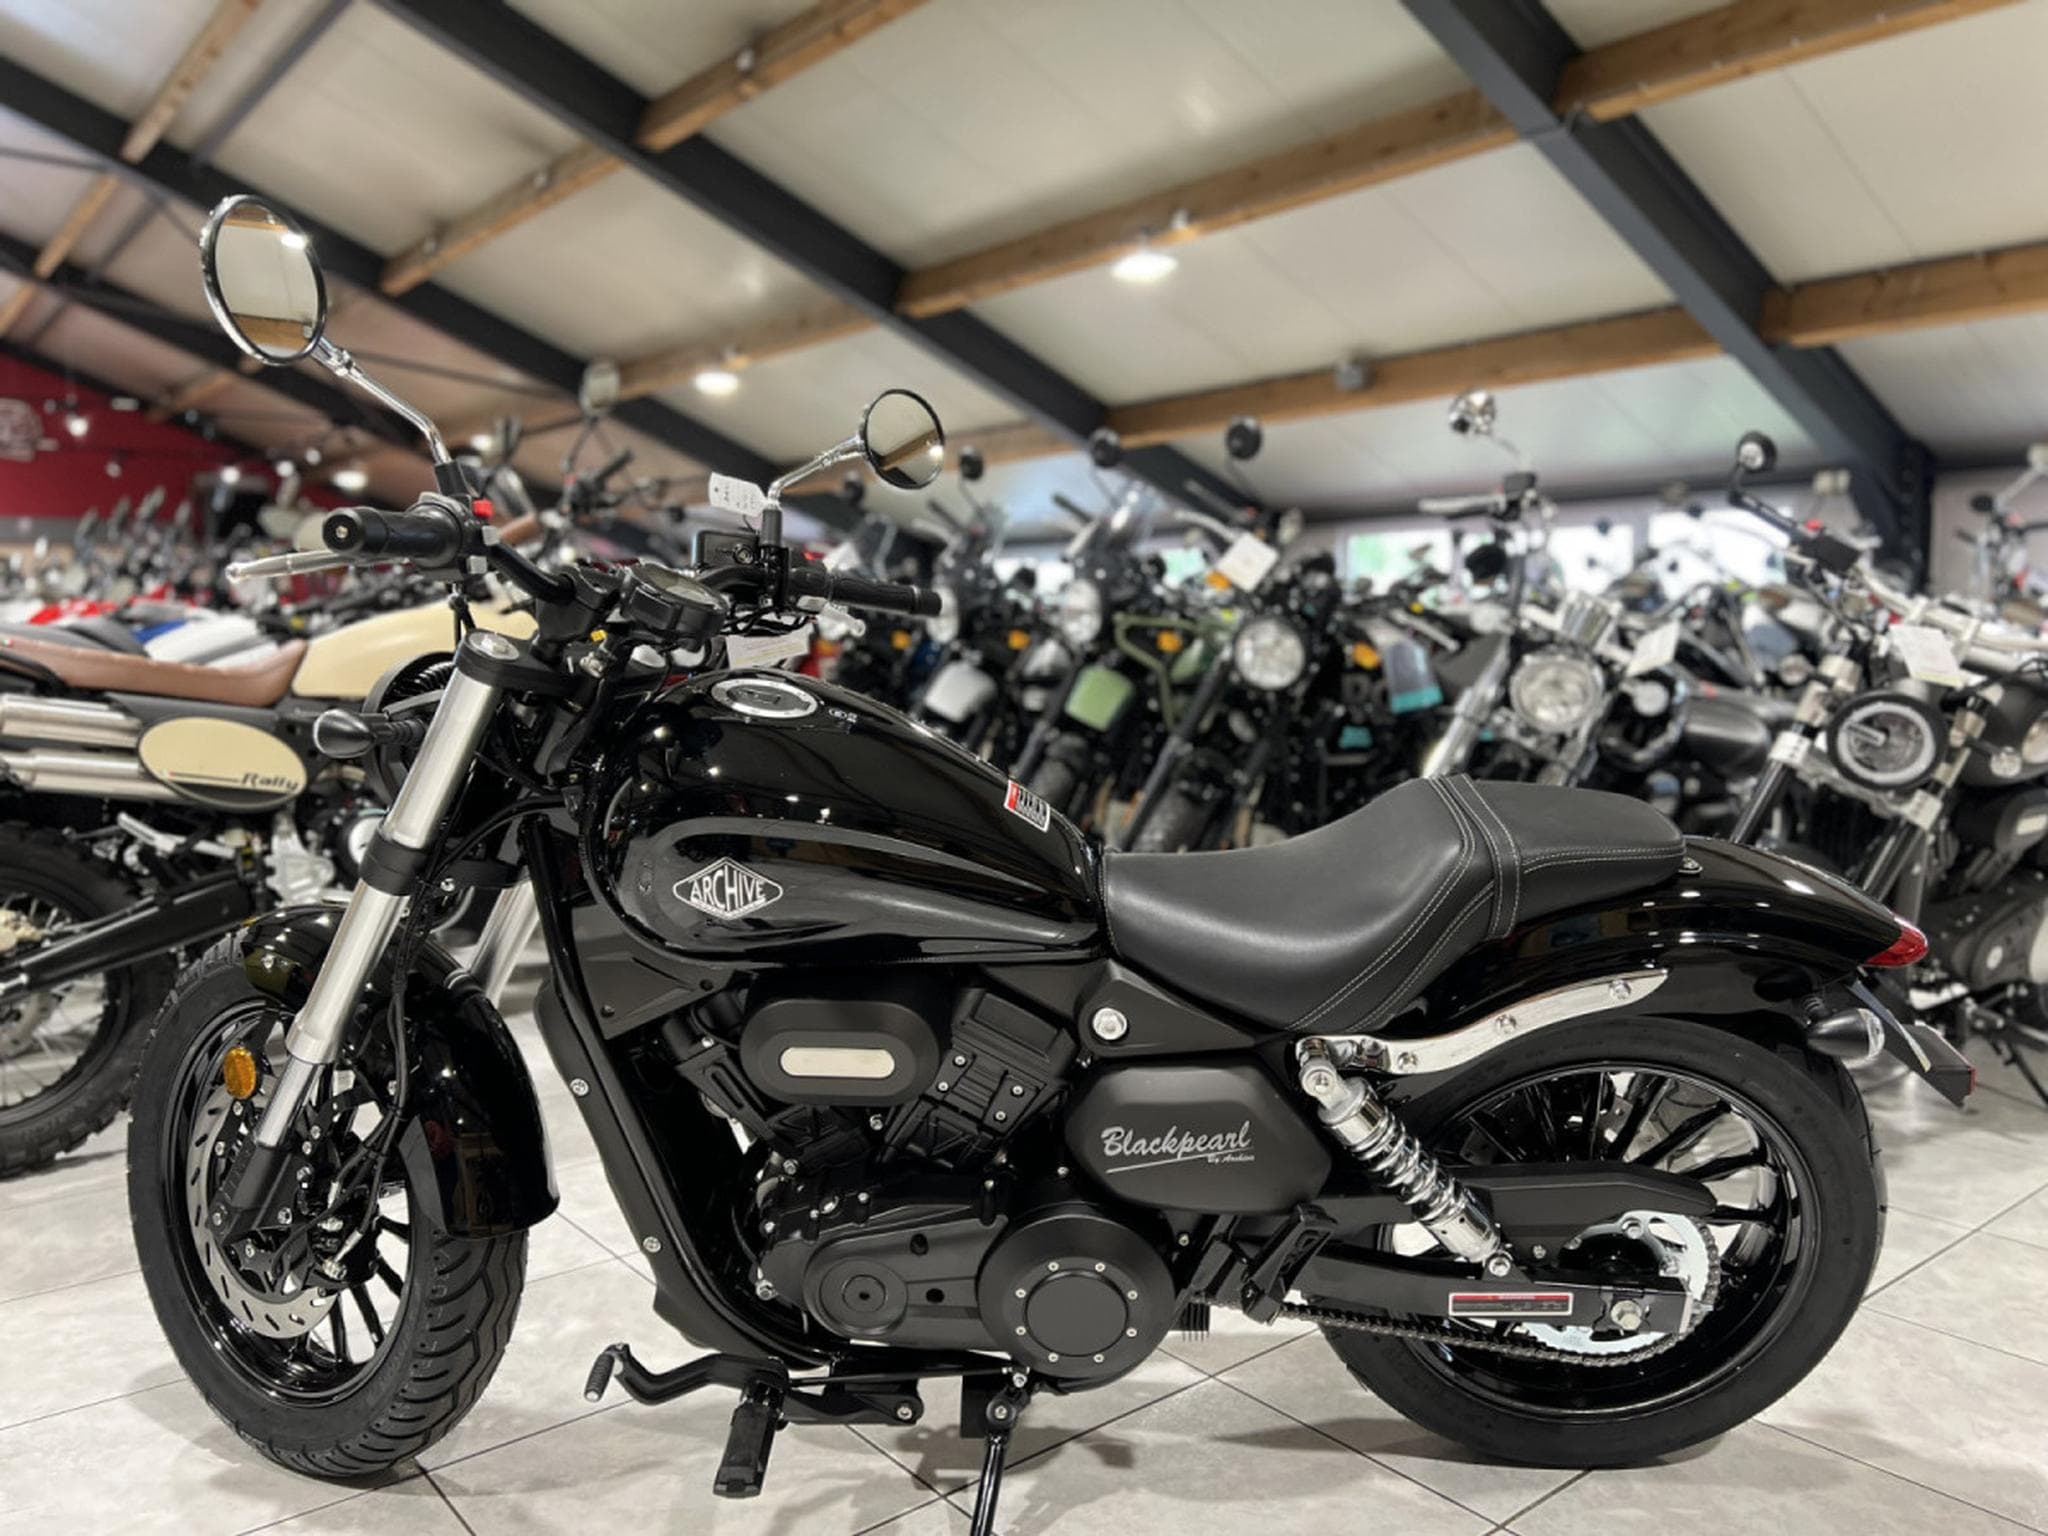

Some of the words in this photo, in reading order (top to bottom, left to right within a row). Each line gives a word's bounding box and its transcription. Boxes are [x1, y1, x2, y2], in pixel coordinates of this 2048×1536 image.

[241, 772, 299, 791] Rally
[689, 864, 767, 912] ARCHIVE
[1100, 1120, 1252, 1160] Blackpearl
